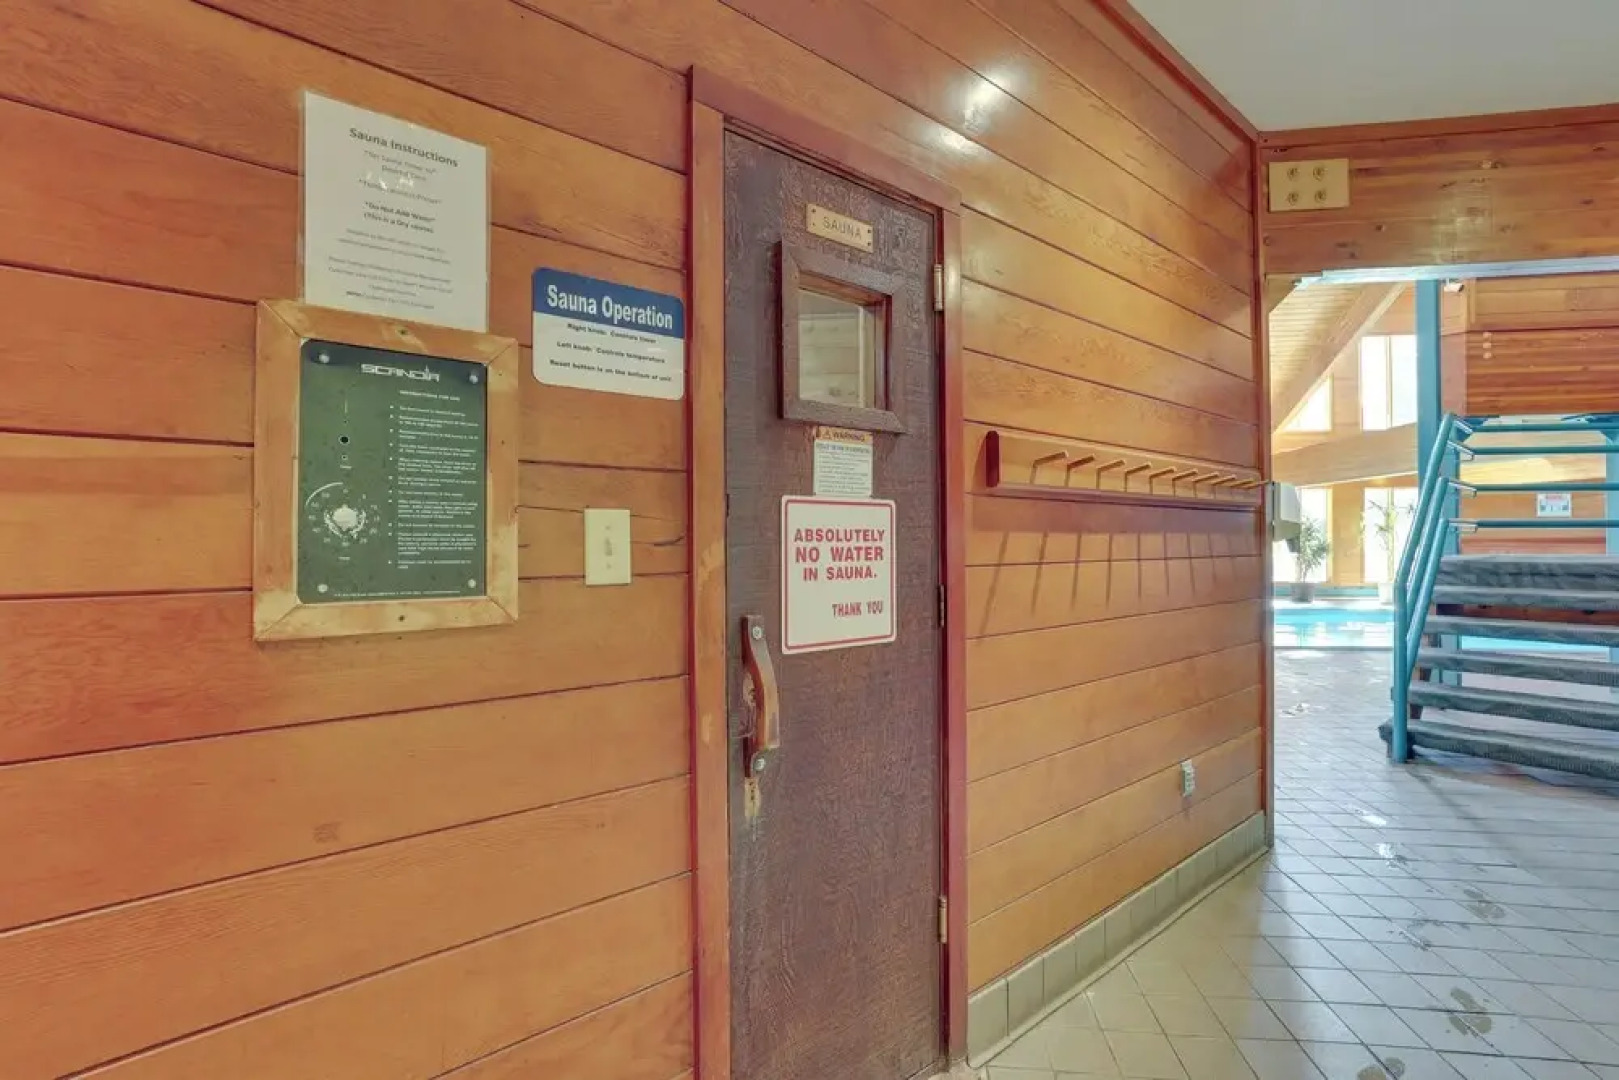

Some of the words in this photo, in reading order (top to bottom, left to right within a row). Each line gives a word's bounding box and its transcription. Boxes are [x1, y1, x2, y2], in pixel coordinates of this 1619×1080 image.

[349, 127, 388, 147] Sauna
[391, 139, 458, 168] Instructions
[823, 216, 862, 241] SAUNA
[547, 284, 597, 315] Sauna
[602, 295, 673, 330] Operation
[567, 323, 587, 333] Right
[556, 341, 572, 349] Left
[794, 527, 885, 542] ABSOLUTELY
[795, 546, 820, 563] NO
[830, 546, 884, 562] WATER
[803, 567, 819, 581] IN
[826, 565, 878, 581] SAUNA.
[832, 602, 862, 617] THANK
[866, 600, 884, 615] YOU
